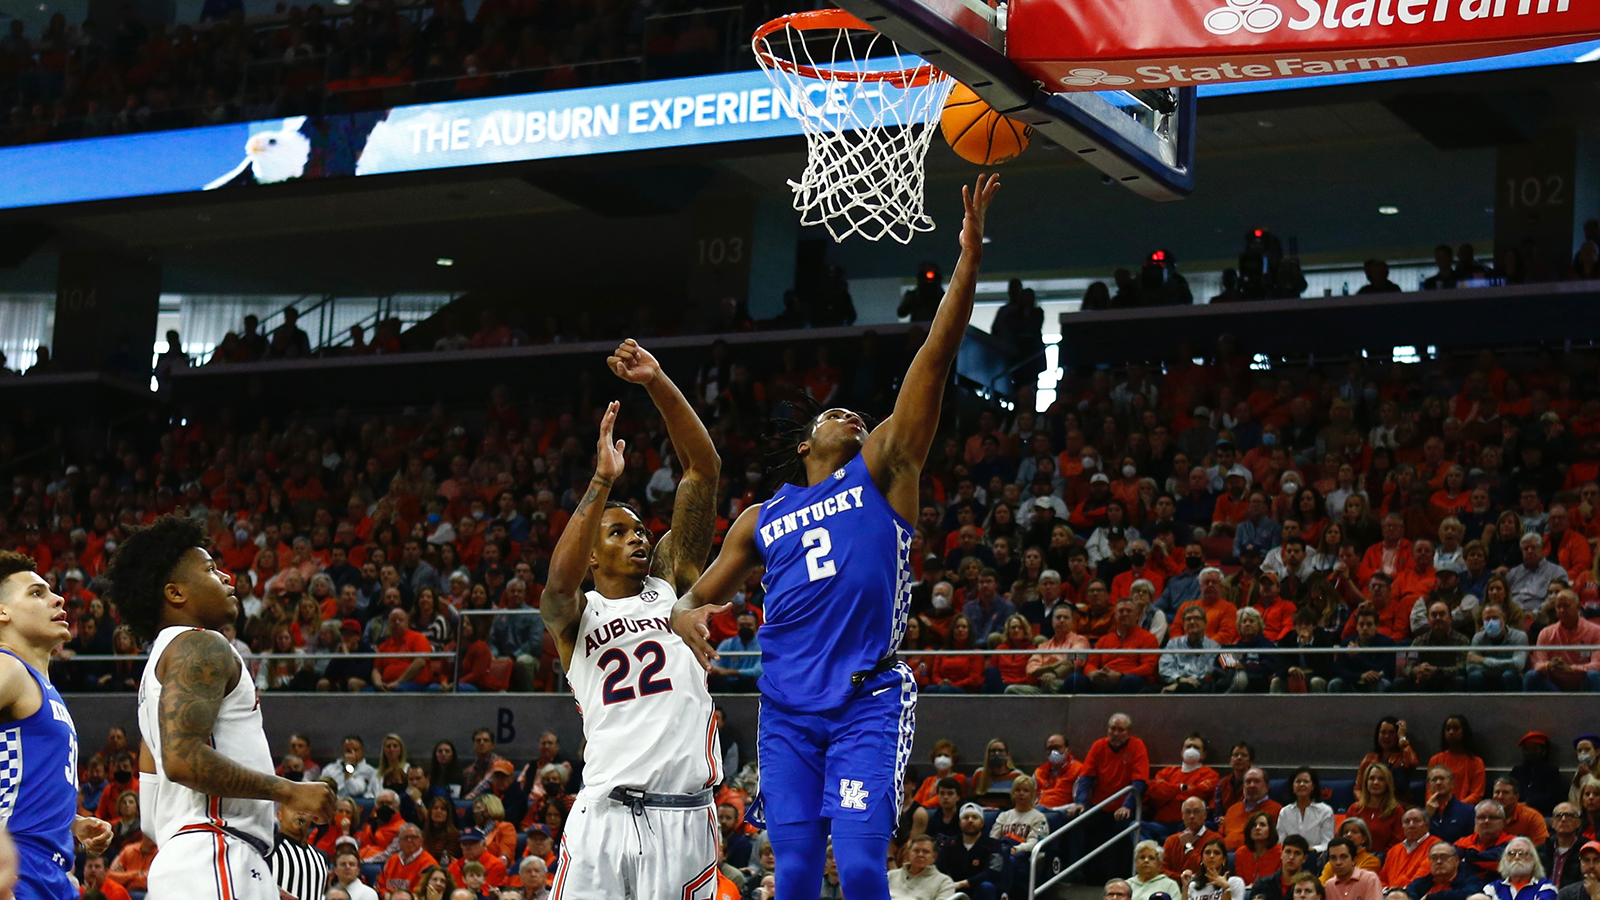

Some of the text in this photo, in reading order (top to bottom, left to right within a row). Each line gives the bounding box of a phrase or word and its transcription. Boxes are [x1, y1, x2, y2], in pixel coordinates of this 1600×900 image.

[408, 80, 849, 153] THE AUBURN EXPERIENCE
[1507, 175, 1563, 207] 102
[698, 236, 743, 265] 103
[62, 288, 97, 312] 104
[760, 486, 863, 548] KENTUCKY
[801, 527, 837, 582] 2
[585, 617, 673, 658] AUBURN
[597, 640, 673, 706] 22
[497, 707, 515, 744] B
[839, 779, 869, 810] UK
